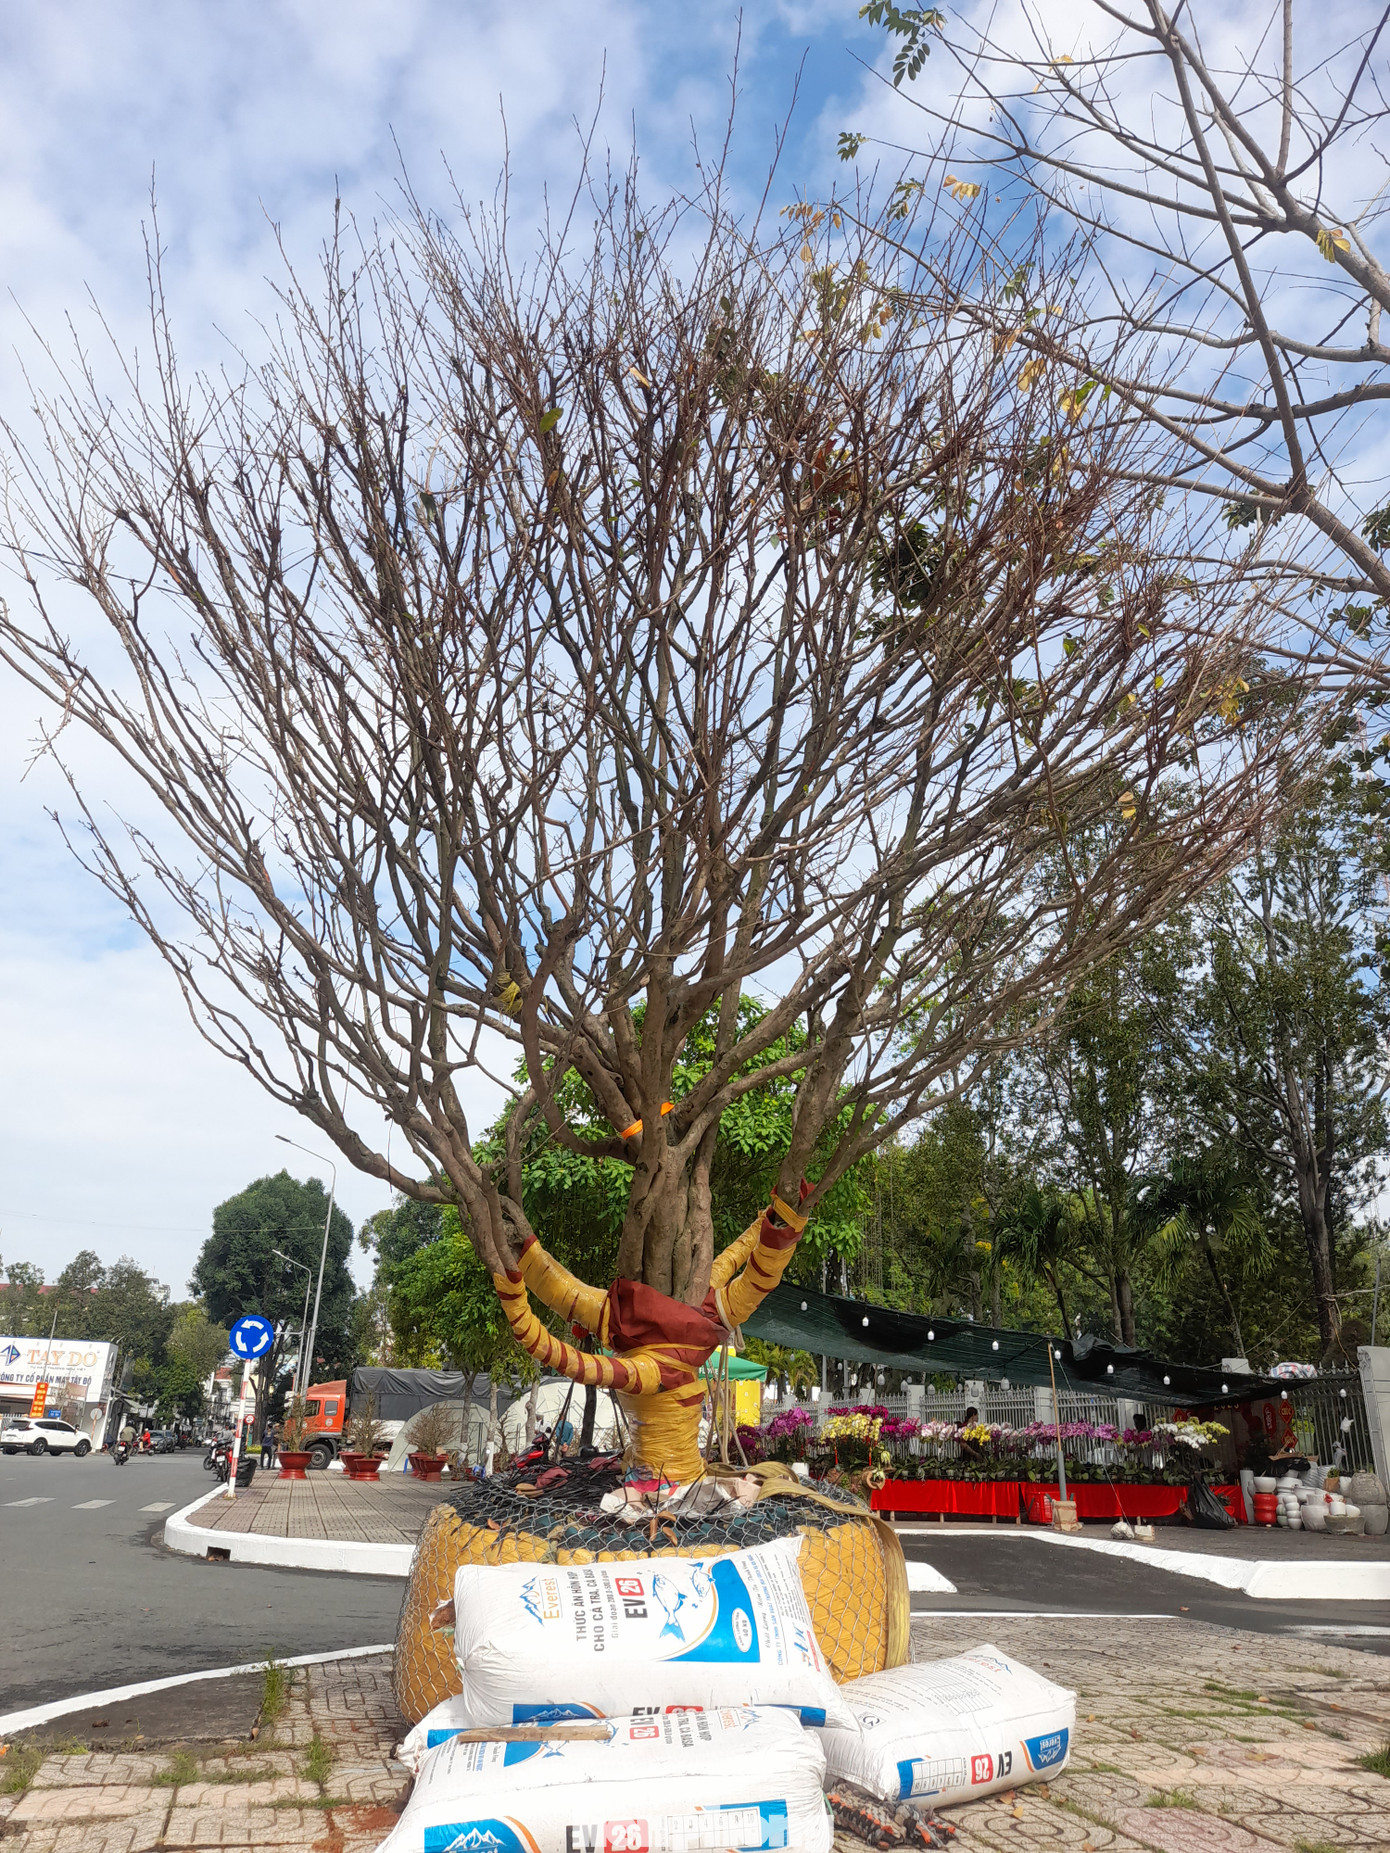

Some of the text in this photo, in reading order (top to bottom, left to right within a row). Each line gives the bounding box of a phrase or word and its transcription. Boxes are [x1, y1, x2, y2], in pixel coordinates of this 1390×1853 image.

[0, 1372, 14, 1381] ÔNG
[16, 1374, 24, 1382] TY
[542, 1578, 560, 1619] Everest
[617, 1578, 648, 1618] EV 26
[573, 1610, 587, 1641] THỨC
[589, 1607, 604, 1621] CÁ
[593, 1625, 605, 1652] CHO
[632, 1727, 656, 1738] 26
[1040, 1735, 1060, 1750] Everest
[975, 1757, 990, 1782] 26
[996, 1751, 1012, 1778] EV
[565, 1824, 598, 1853] EV
[610, 1823, 641, 1851] 26
